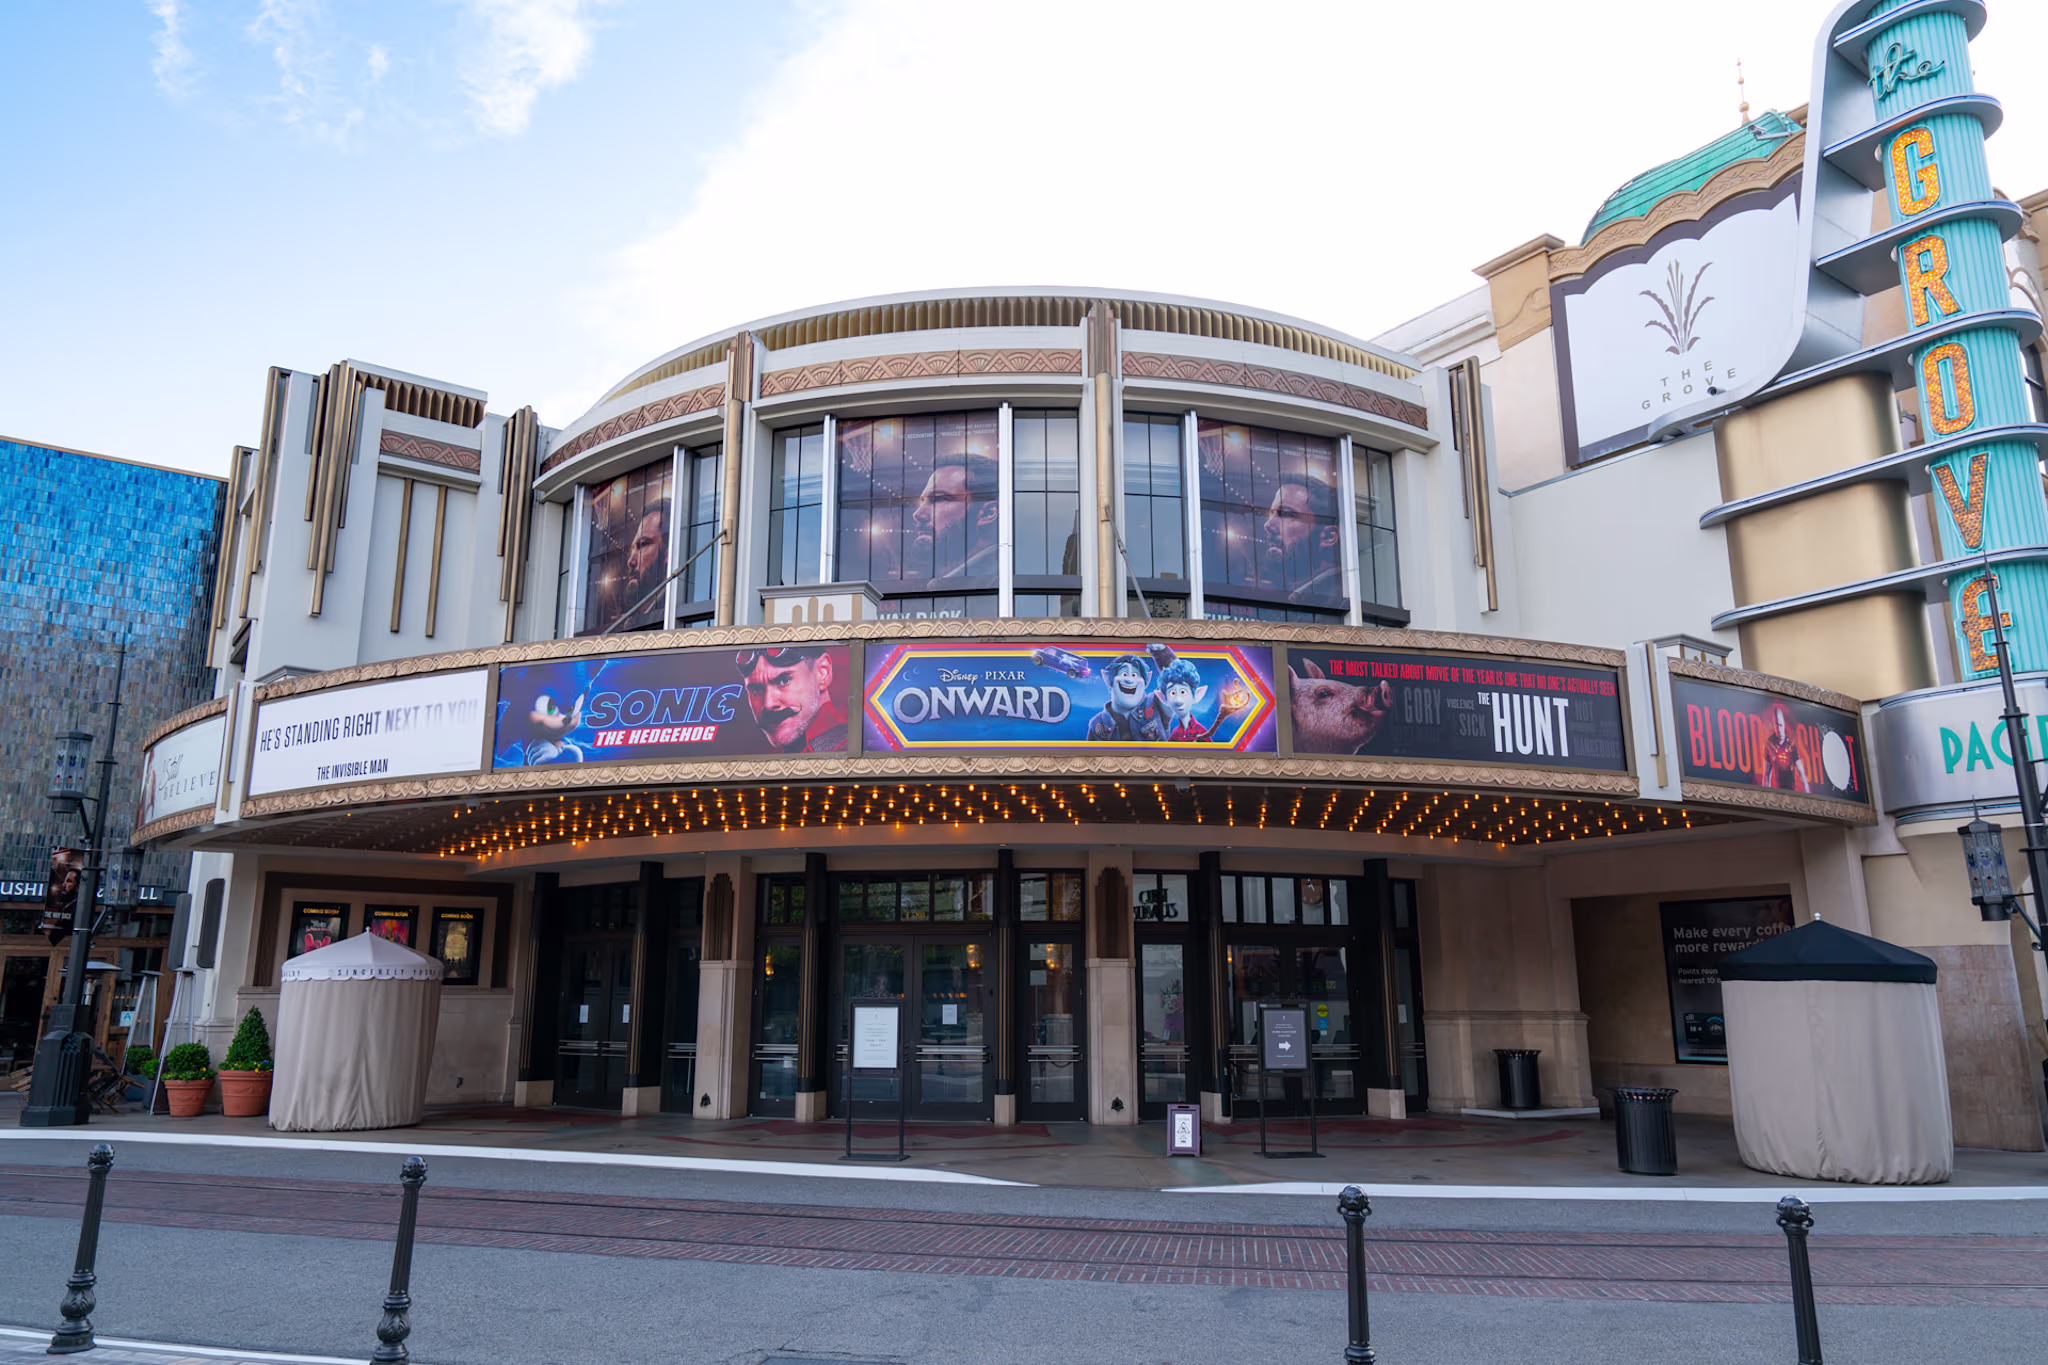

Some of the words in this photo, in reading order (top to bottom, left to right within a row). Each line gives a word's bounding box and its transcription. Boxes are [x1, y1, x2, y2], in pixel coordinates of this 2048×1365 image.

[1867, 42, 1945, 100] the
[1660, 360, 1713, 388] THE
[1641, 368, 1737, 410] GROVE
[1889, 126, 2012, 673] GROVE
[985, 671, 1026, 681] PIXAR
[1329, 659, 1344, 675] THE
[1346, 660, 1369, 677] MOST
[1370, 662, 1399, 679] TALKED
[1400, 663, 1424, 680] ABOUT
[1426, 665, 1450, 682] MOVIE
[1451, 667, 1460, 683] OF
[1461, 668, 1476, 684] THE
[1476, 669, 1496, 686] YEAR
[1496, 670, 1503, 686] IS
[1504, 671, 1519, 687] ONE
[1519, 672, 1536, 689] THAT
[1537, 674, 1547, 690] NO
[1547, 675, 1566, 692] ONE'S
[1567, 677, 1598, 695] ACTUALLY
[1599, 681, 1616, 697] SEEN
[584, 684, 743, 728] SONIC
[893, 686, 1071, 725] ONWARD
[1404, 687, 1441, 725] GORY
[1446, 698, 1475, 710] VIOLENCE
[260, 728, 282, 752] HE'S
[284, 717, 339, 748] STANDING
[343, 711, 382, 738] RIGHT
[385, 706, 420, 734] NEXT
[425, 703, 442, 729] TO
[597, 731, 627, 746] THE
[628, 726, 716, 744] HEDGEHOG
[1459, 712, 1487, 737] SICK
[1477, 691, 1490, 705] THE
[1491, 692, 1569, 757] HUNT
[317, 766, 330, 781] THE
[331, 761, 368, 779] INVISIBLE
[369, 758, 389, 774] MAN
[163, 771, 216, 801] BELIEVE
[0, 881, 44, 897] USHI
[1673, 927, 1709, 939] Make
[1712, 926, 1751, 938] every
[1675, 942, 1709, 953] more
[338, 968, 405, 976] SINCERELY
[1678, 967, 1700, 975] Points
[1679, 977, 1705, 985] nearest
